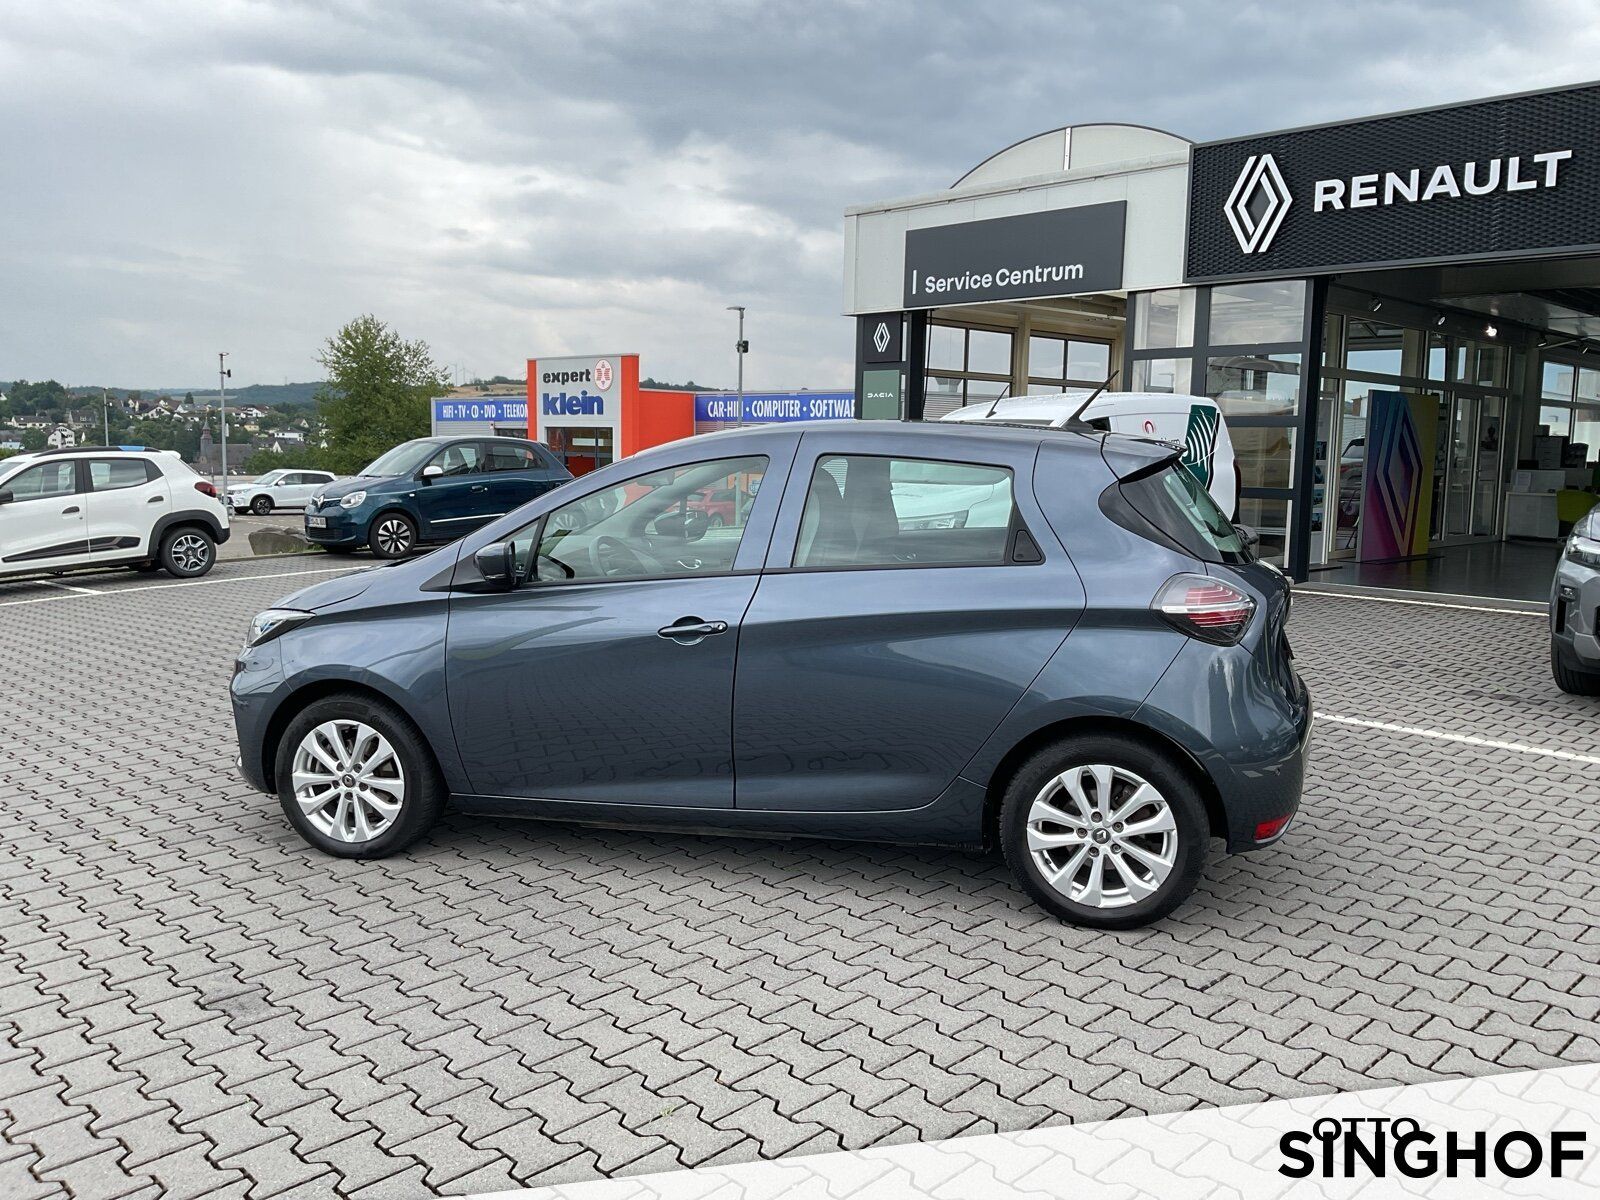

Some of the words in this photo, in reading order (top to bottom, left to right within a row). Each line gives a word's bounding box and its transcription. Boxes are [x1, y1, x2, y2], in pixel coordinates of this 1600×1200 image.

[1313, 149, 1573, 213] RENAULT
[925, 271, 993, 294] Service
[995, 263, 1084, 287] Centrum
[542, 368, 591, 386] expert
[458, 405, 466, 418] TV
[471, 405, 479, 418] CD
[484, 404, 496, 418] DVD
[542, 390, 604, 415] klein
[751, 400, 801, 418] COMPUTER
